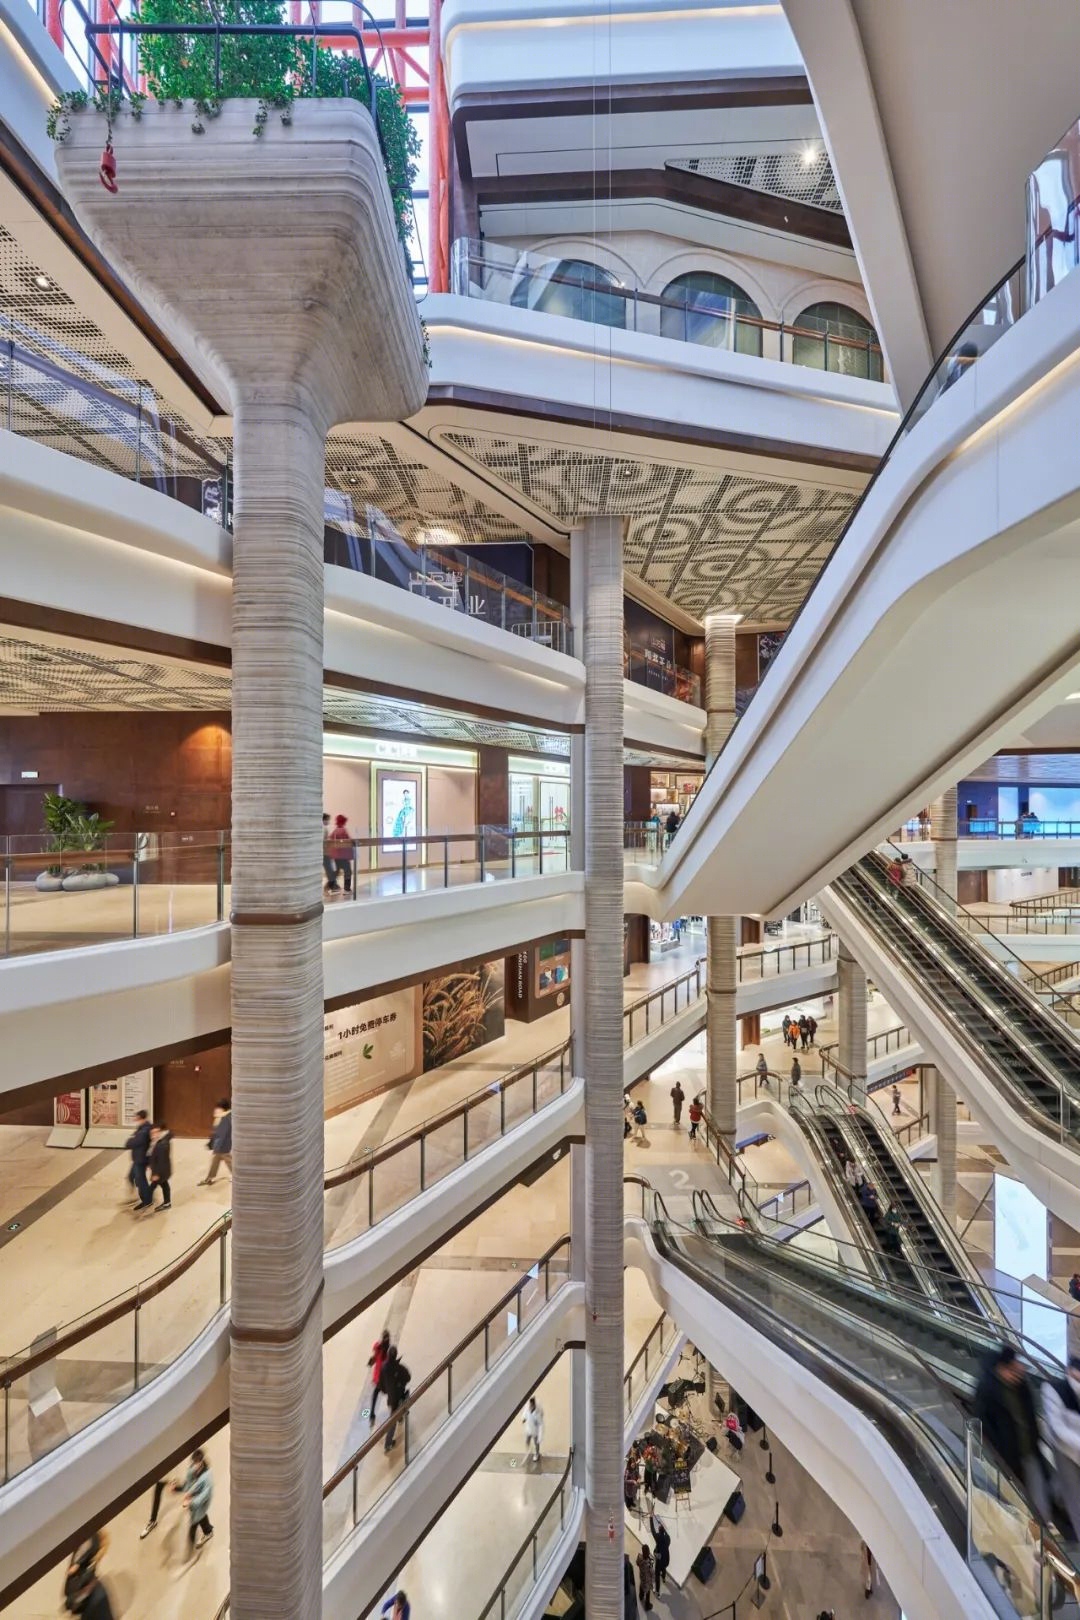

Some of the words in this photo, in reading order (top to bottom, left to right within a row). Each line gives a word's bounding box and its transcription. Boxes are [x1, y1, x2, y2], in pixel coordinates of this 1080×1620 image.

[338, 1012, 397, 1040] 1小时免费停车券
[668, 1169, 696, 1190] 2
